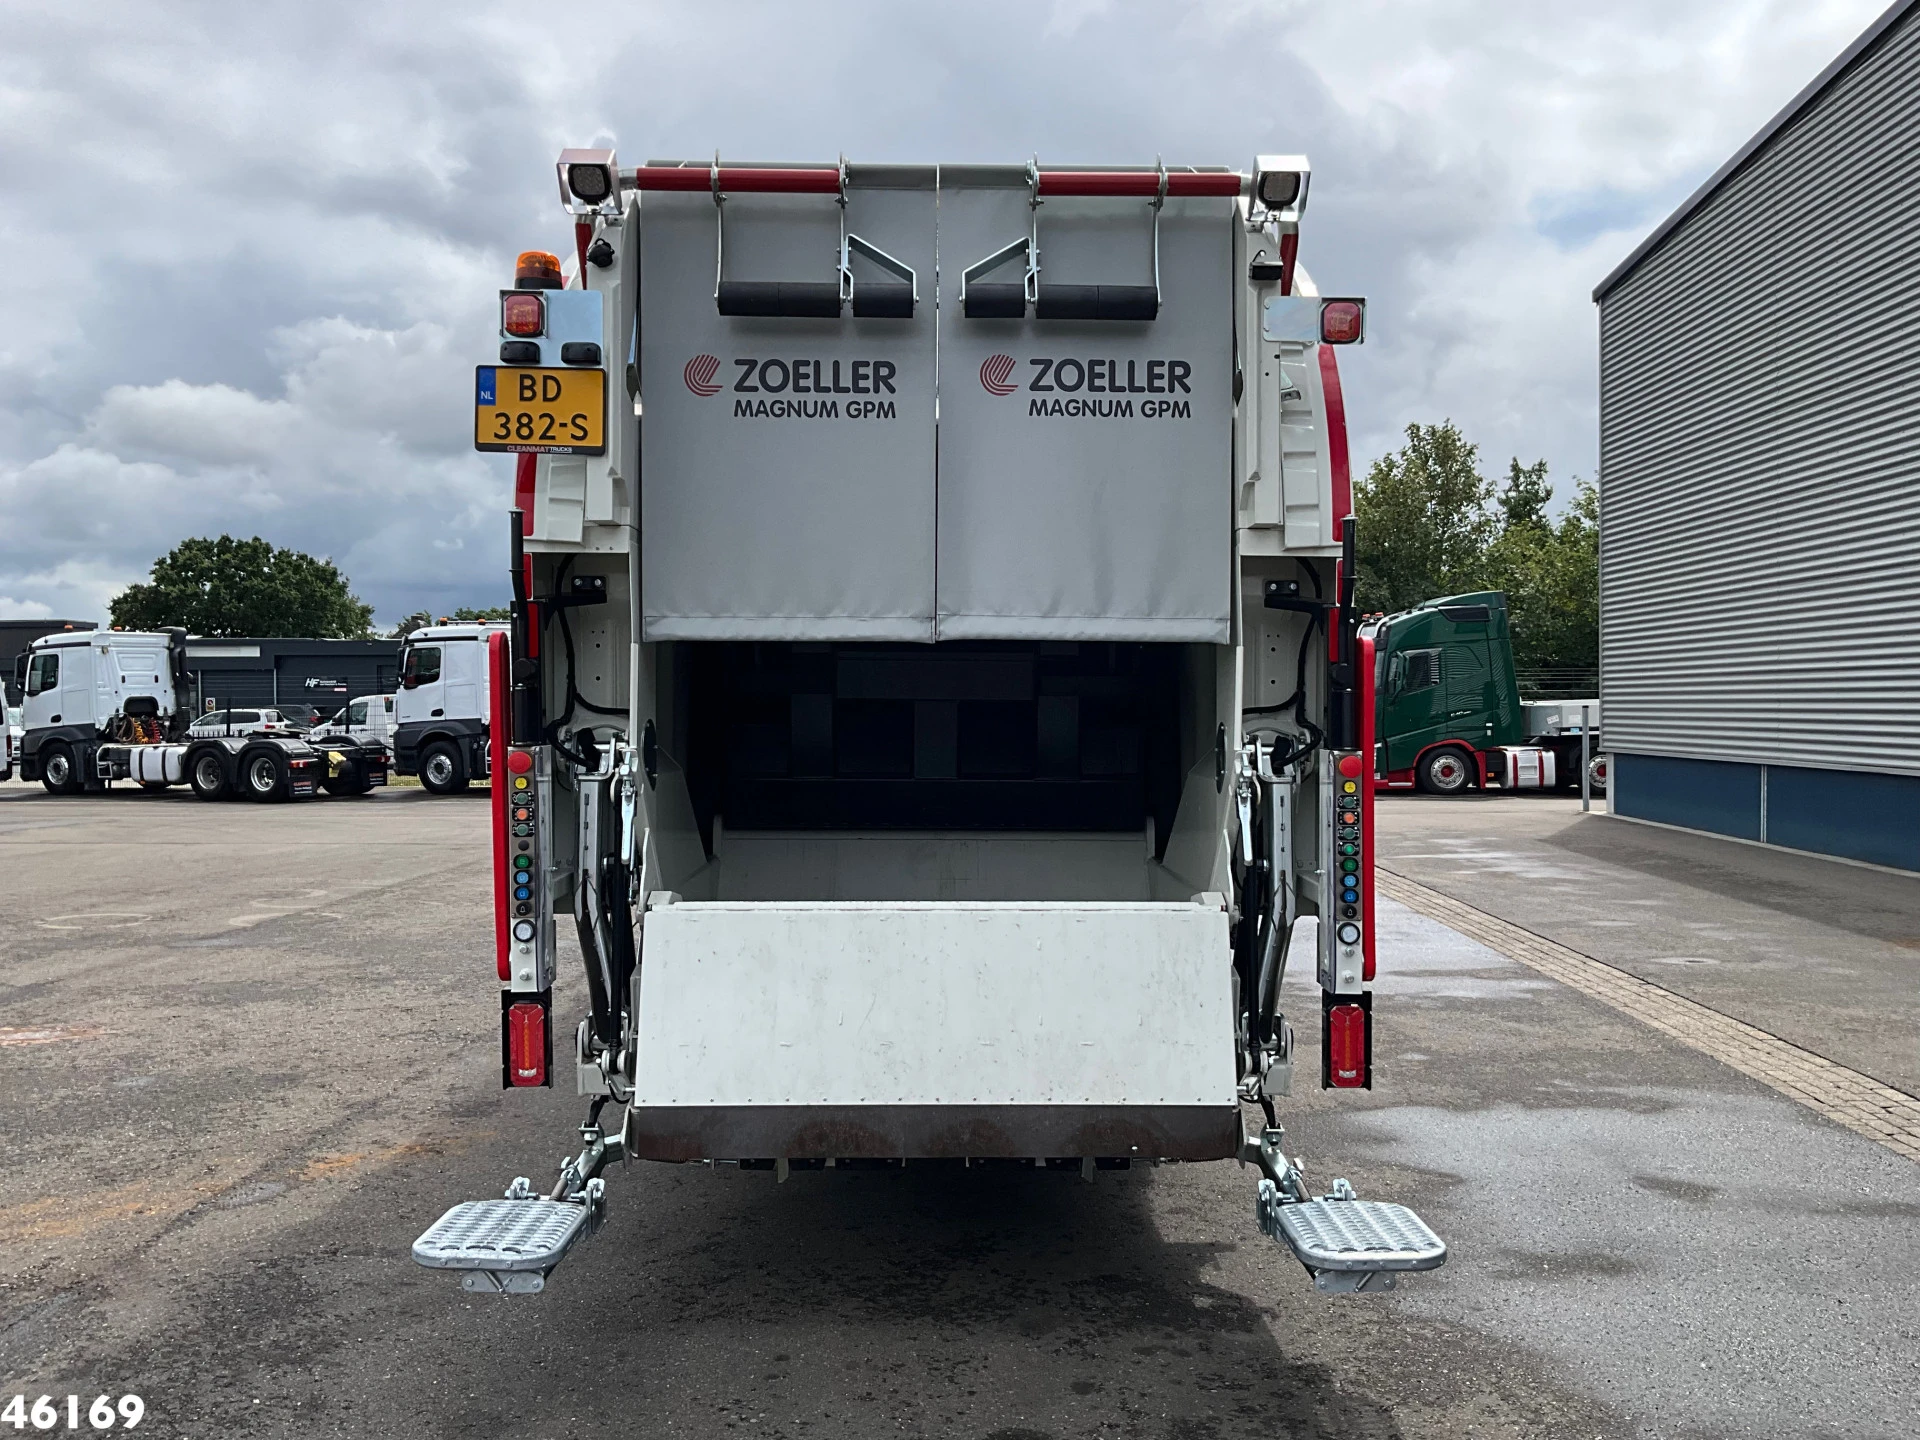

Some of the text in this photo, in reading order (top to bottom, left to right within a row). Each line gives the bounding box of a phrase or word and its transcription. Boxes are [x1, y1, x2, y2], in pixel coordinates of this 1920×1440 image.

[519, 373, 562, 402] BD
[733, 358, 897, 394] ZOELLER
[1028, 358, 1192, 394] ZOELLER
[480, 390, 493, 400] NL
[733, 399, 897, 419] MAGNUM GPM
[1028, 398, 1192, 418] MAGNUM GPM
[493, 411, 589, 441] 382-S
[305, 677, 320, 688] HF
